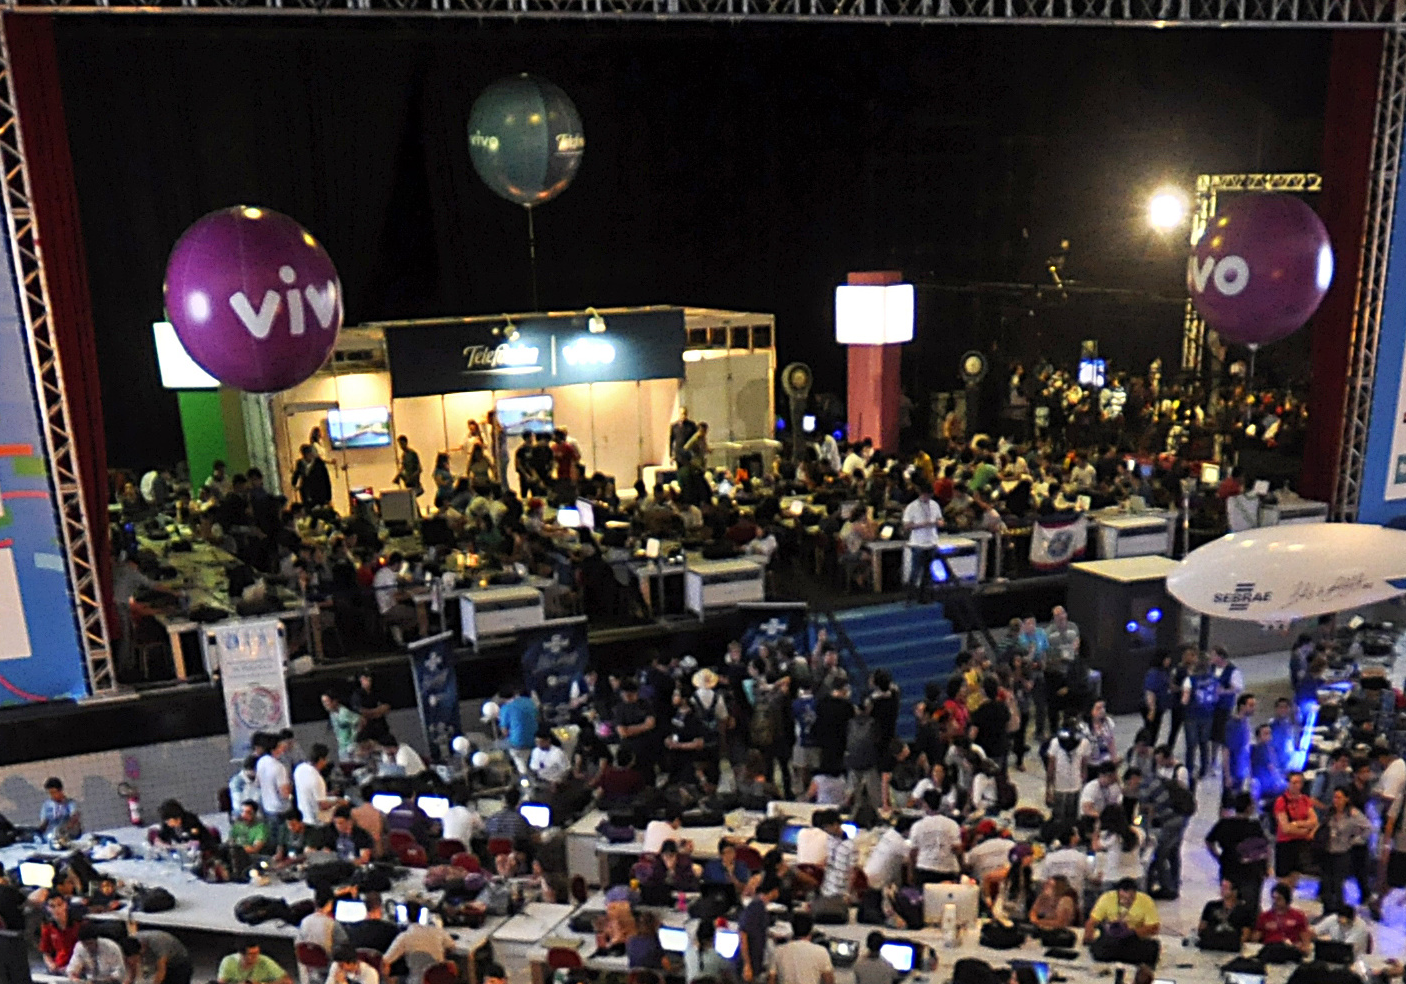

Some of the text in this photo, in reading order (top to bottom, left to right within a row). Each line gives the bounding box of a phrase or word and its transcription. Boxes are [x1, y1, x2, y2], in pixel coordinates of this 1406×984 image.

[1188, 255, 1250, 295] vo
[229, 265, 337, 338] viv
[1213, 590, 1273, 604] SEBRAE
